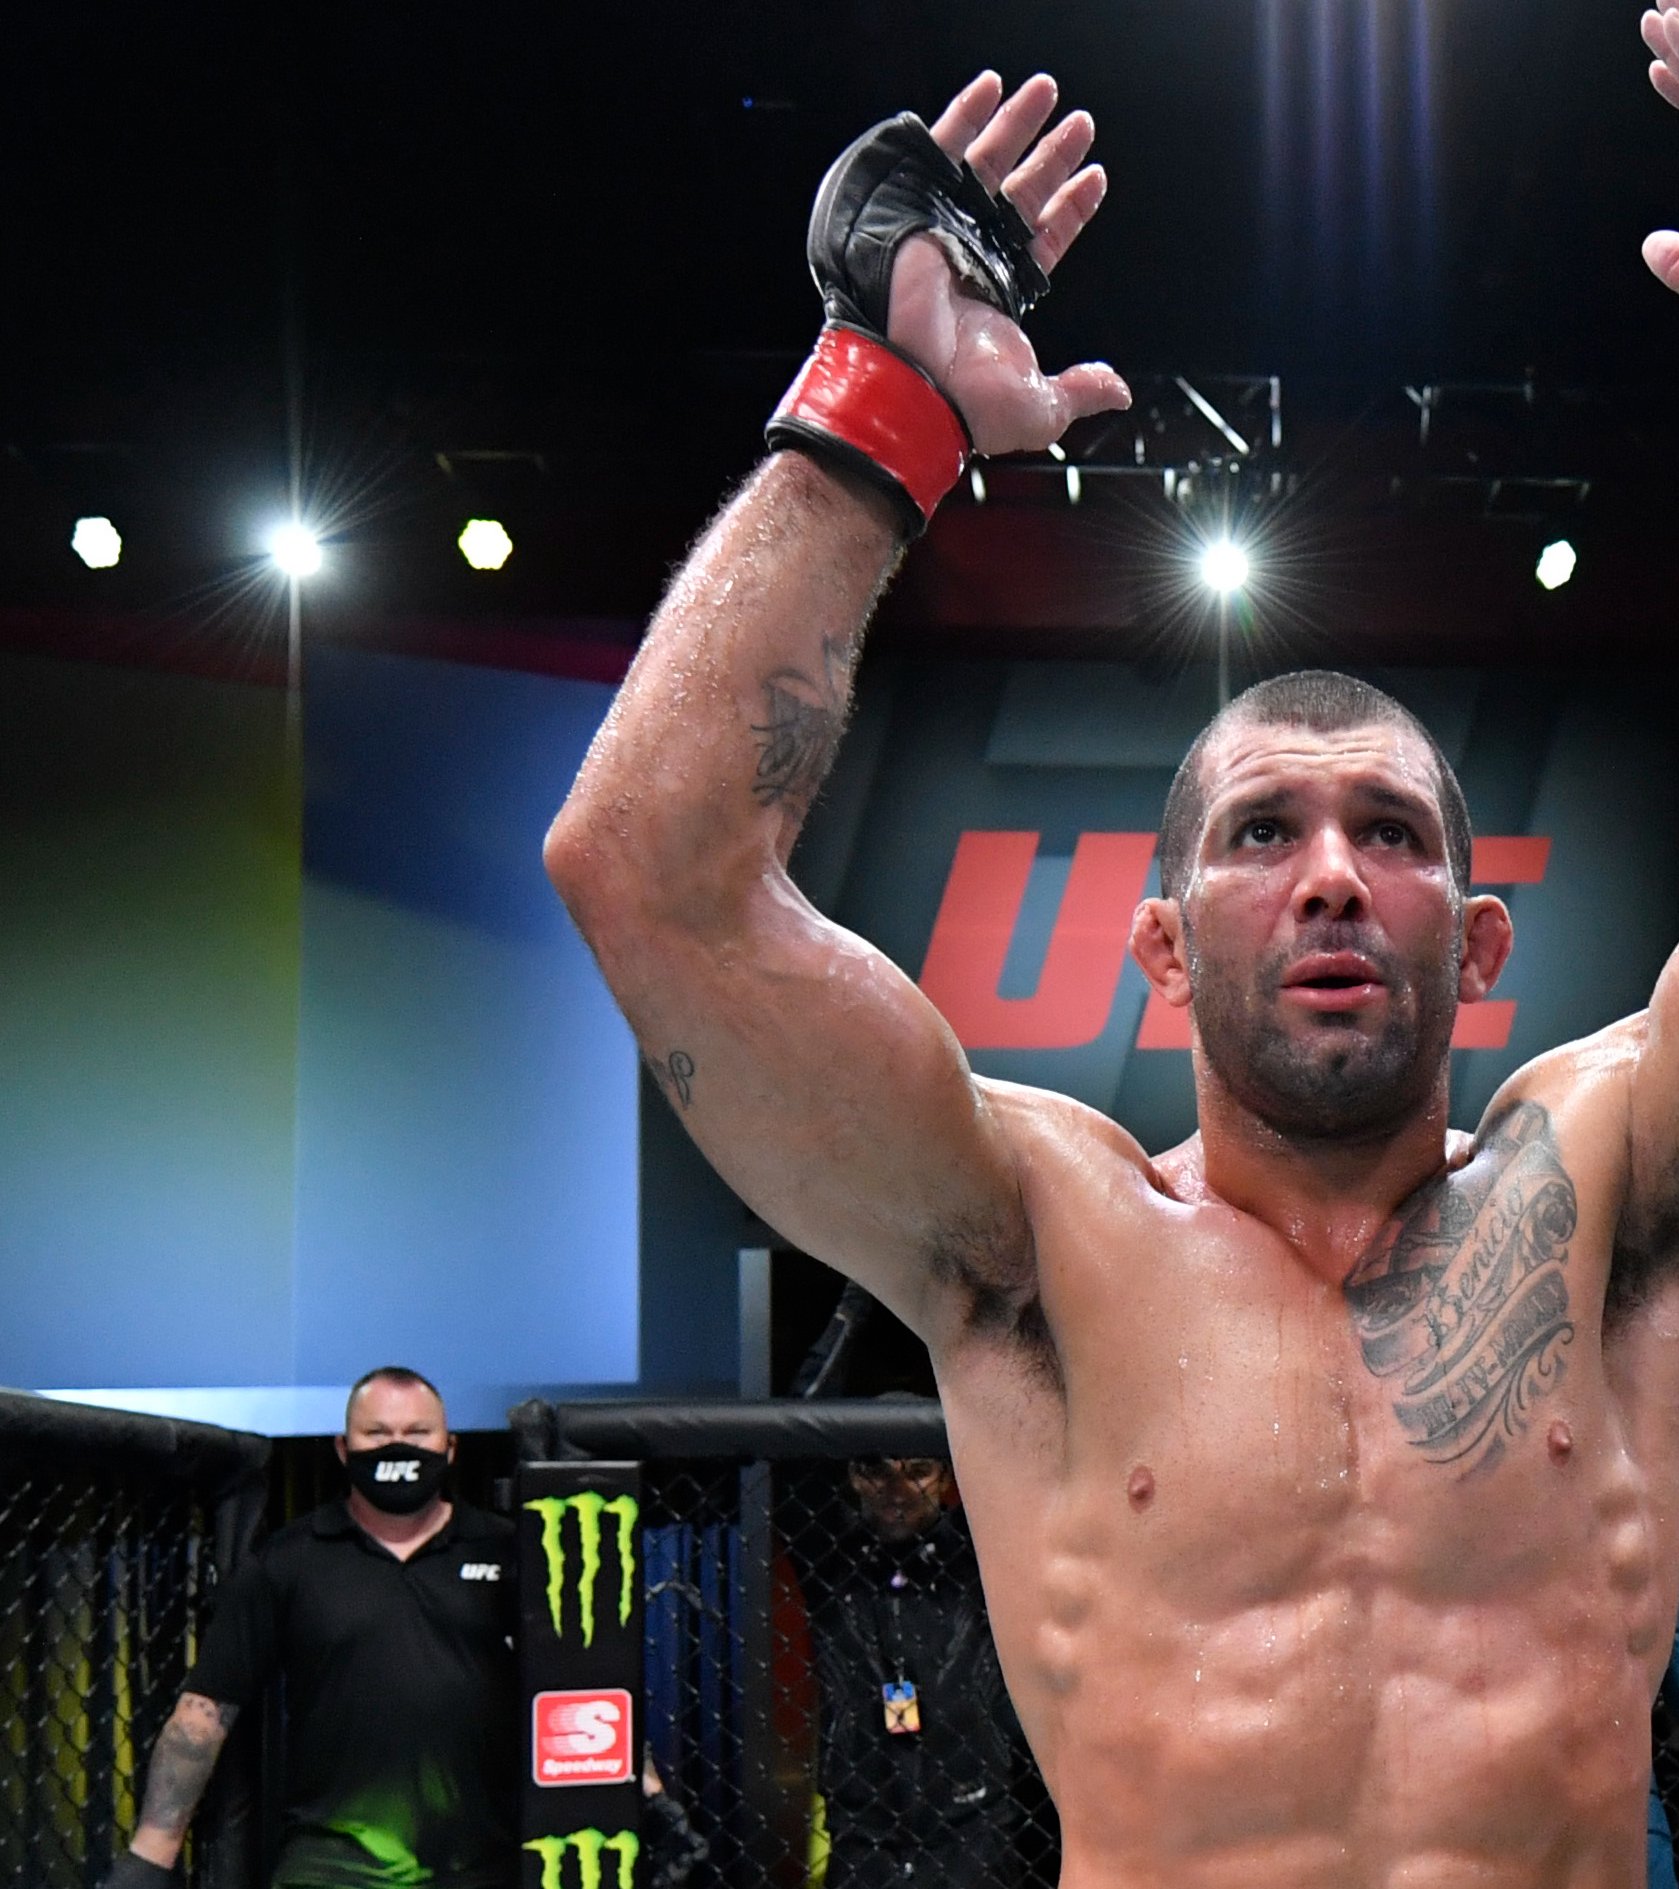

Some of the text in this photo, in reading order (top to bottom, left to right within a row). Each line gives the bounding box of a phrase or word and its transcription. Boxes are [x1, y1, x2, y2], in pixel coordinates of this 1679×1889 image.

[374, 1460, 421, 1483] UFC
[460, 1563, 501, 1582] UFC
[543, 1757, 622, 1777] Speedway
